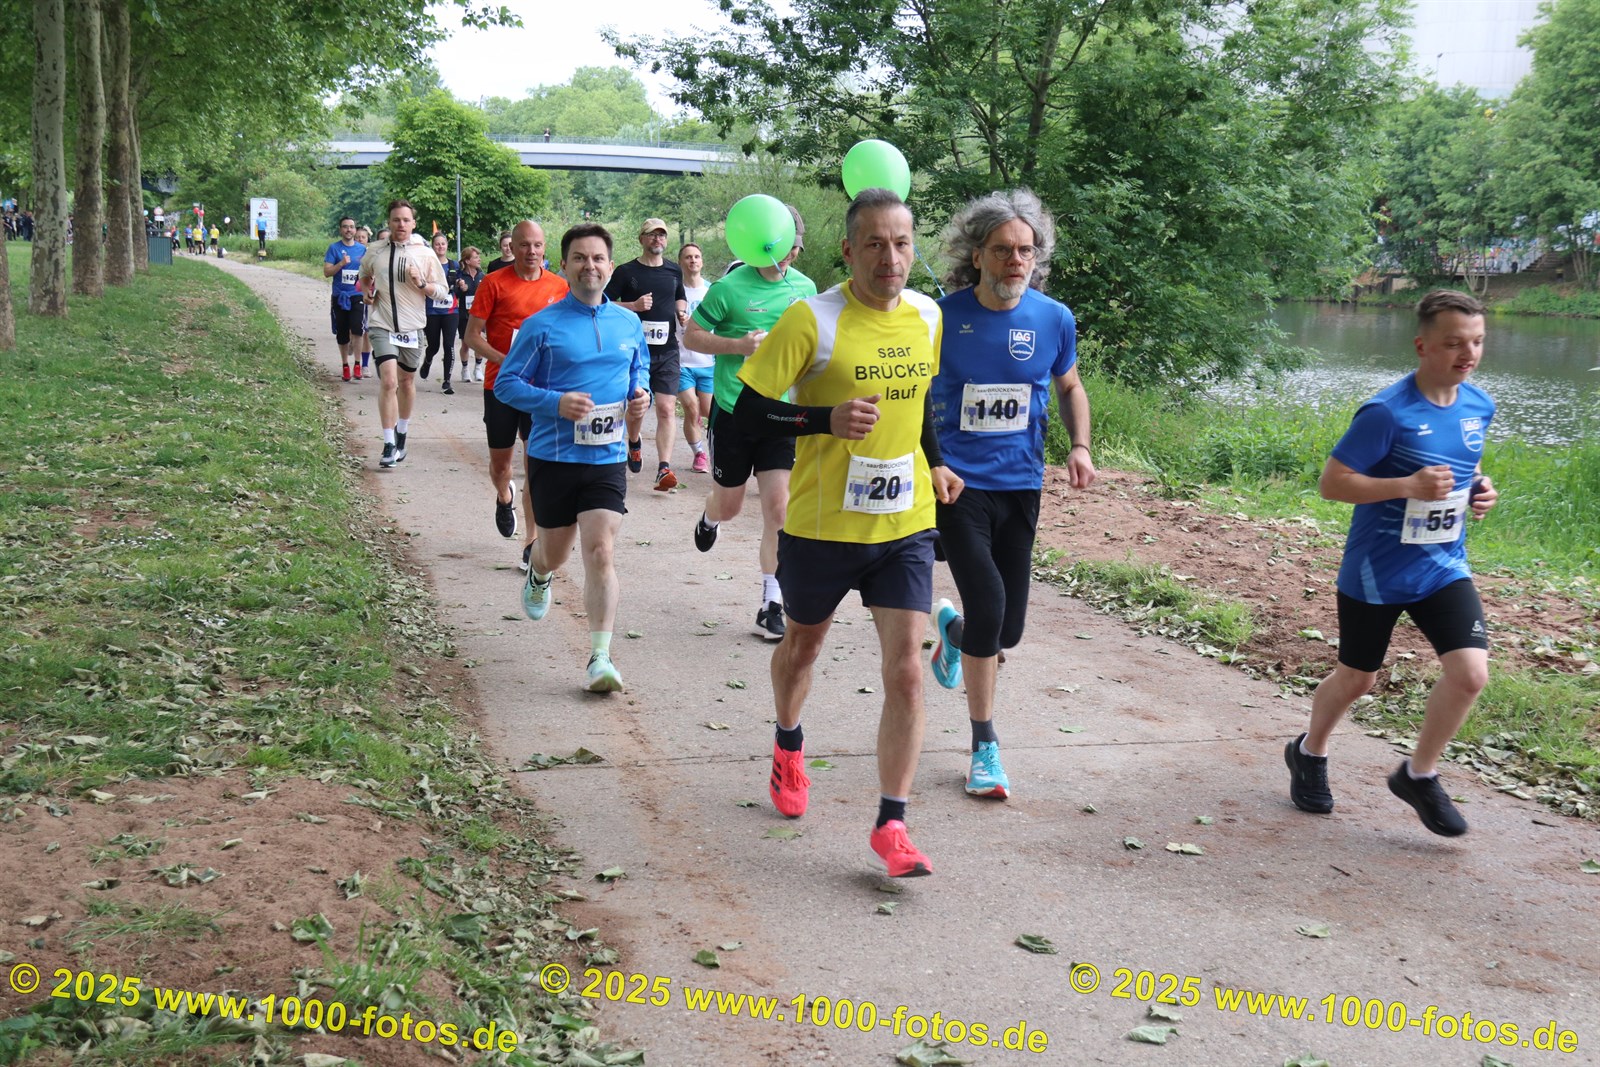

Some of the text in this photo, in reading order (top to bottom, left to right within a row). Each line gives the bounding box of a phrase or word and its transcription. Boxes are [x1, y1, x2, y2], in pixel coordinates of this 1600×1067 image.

[650, 328, 663, 340] 16
[1012, 331, 1031, 342] LAG
[877, 346, 911, 359] saar
[885, 384, 918, 401] lauf
[975, 398, 1019, 420] 140
[591, 416, 614, 435] 62
[868, 475, 901, 501] 20
[1427, 508, 1456, 531] 55
